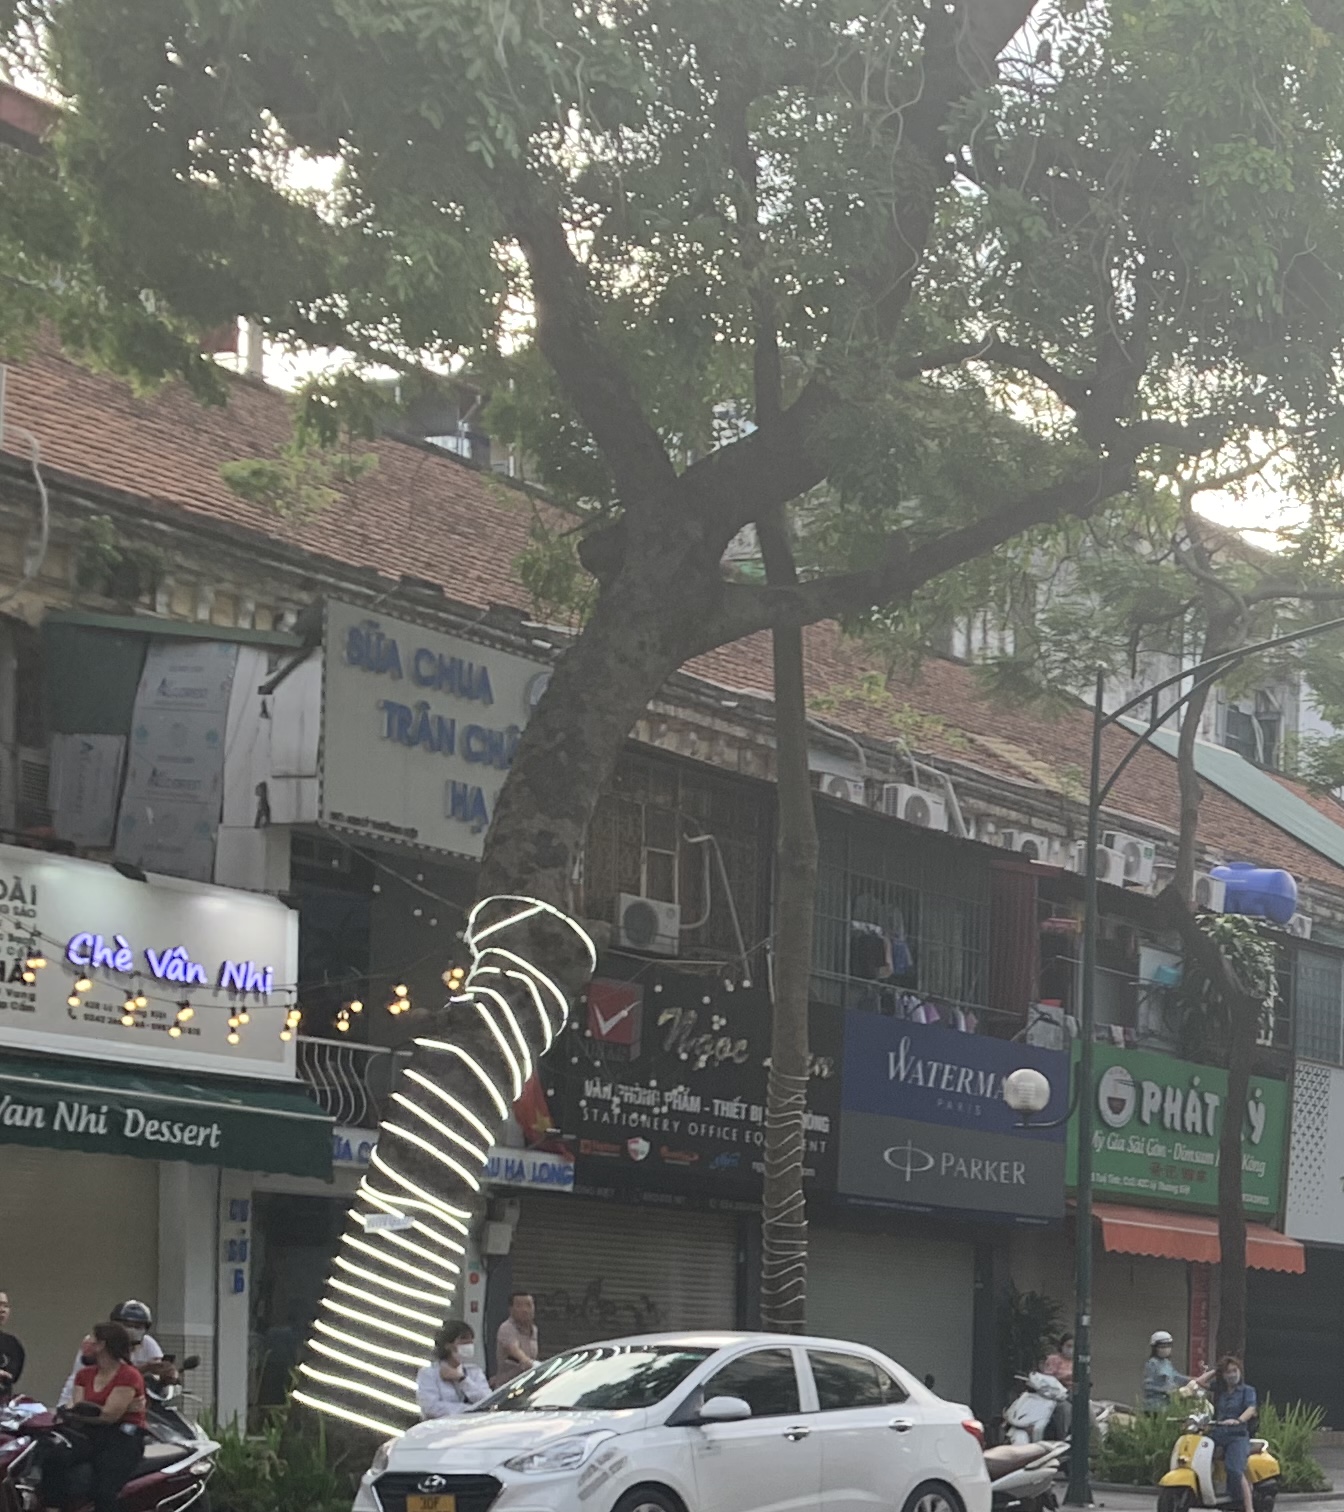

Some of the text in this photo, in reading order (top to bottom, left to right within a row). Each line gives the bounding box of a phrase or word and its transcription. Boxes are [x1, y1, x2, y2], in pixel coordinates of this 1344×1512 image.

[345, 619, 494, 705] SỮA CHUA
[380, 699, 456, 757] TRÂN
[67, 931, 133, 972] Chè
[145, 945, 208, 984] Vân
[220, 960, 275, 995] Nhi
[53, 1100, 108, 1136] Nhi
[123, 1107, 223, 1149] Dessert
[583, 1107, 681, 1133] STATIONERY
[688, 1123, 738, 1142] OFFICE
[713, 1095, 748, 1120] THIẾT
[749, 1105, 763, 1126] BỊ
[937, 1098, 982, 1117] PARIS
[1106, 1132, 1125, 1152] Gia
[530, 1161, 574, 1186] LONG
[940, 1152, 1026, 1185] PARKER
